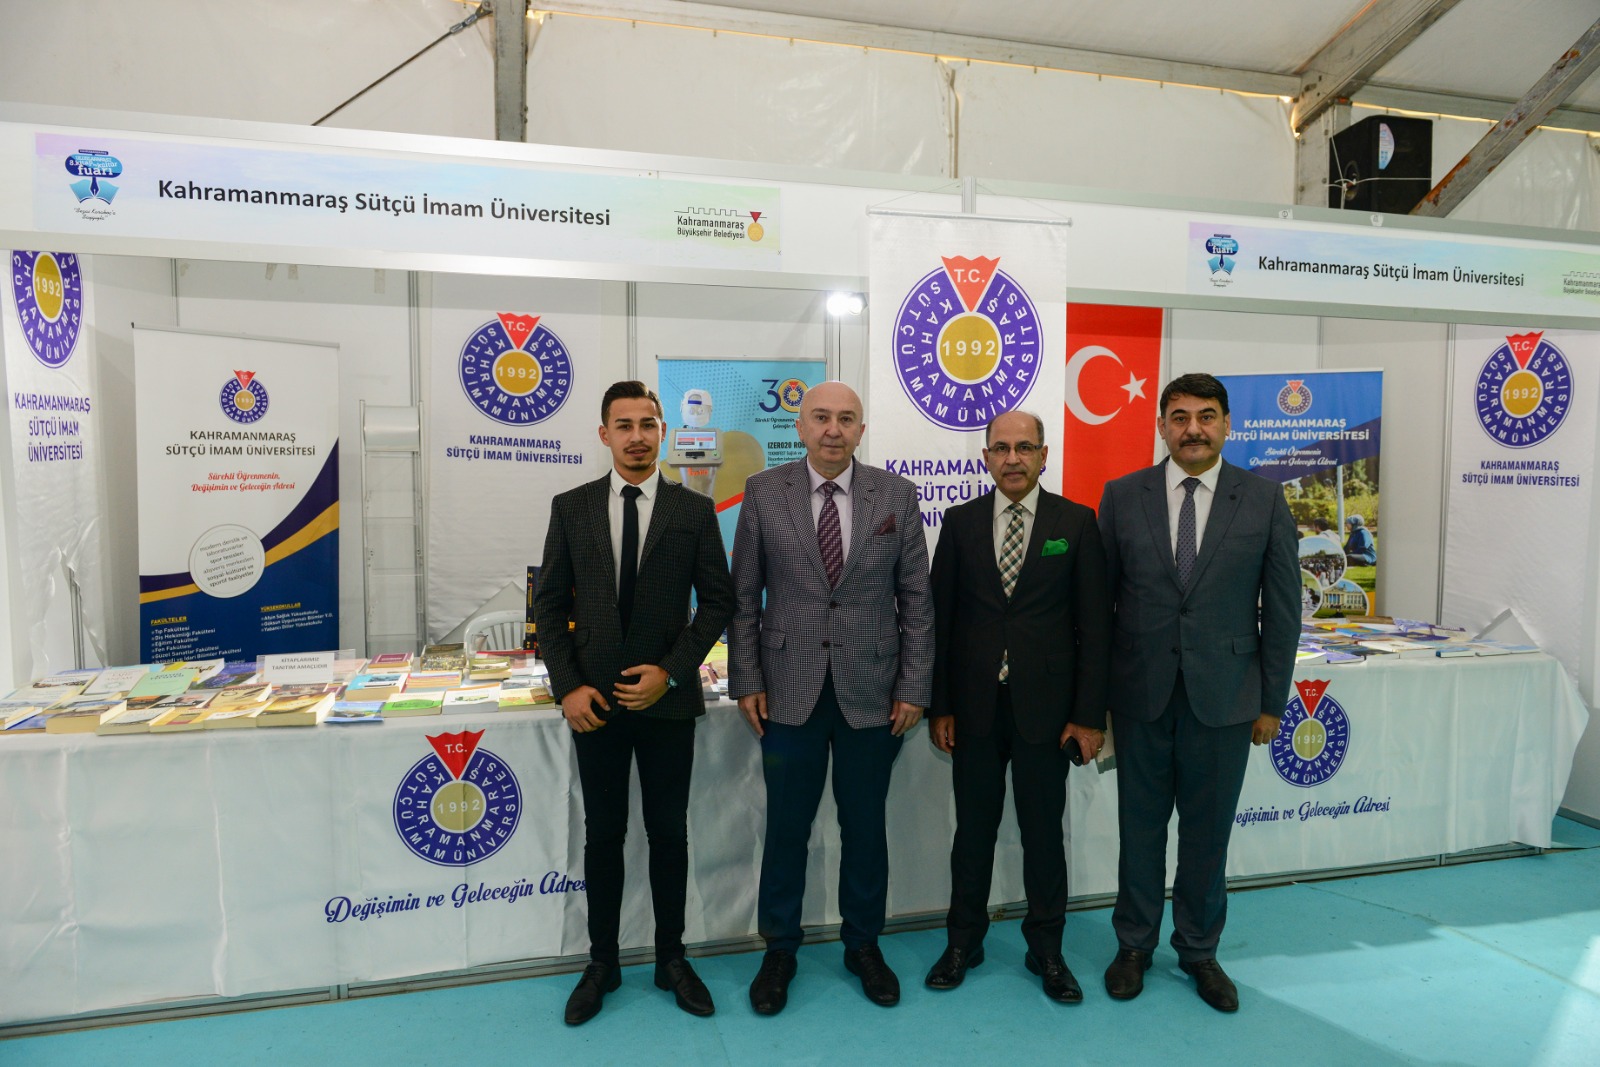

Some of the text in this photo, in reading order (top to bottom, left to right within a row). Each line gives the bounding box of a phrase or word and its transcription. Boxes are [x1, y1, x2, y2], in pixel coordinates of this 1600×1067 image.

[78, 165, 113, 175] fuarı
[158, 180, 610, 226] Kahramanmaraş Sütçü İmam Üniversitesi
[678, 215, 744, 230] Kahramanmaraş
[678, 227, 745, 240] Büyükşehir Belediyesi
[954, 268, 985, 284] T.C.
[1258, 256, 1524, 286] Kahramanmaraş Sütçü İmam Üniversitesi
[35, 276, 61, 298] 1992
[506, 321, 529, 332] T.C.
[900, 281, 1035, 422] SÜTÇÜ İMAM ÜNİVERSİTESİ
[921, 298, 1016, 401] KAHRAMANMARAŞ
[942, 340, 996, 356] 1992
[1513, 341, 1533, 352] T.C.
[463, 328, 496, 375] SÜTÇÜ
[508, 333, 568, 421] ÜNİVERSİTESİ
[480, 339, 554, 407] KAHRAMANMARAŞ
[497, 367, 537, 379] 1992
[1490, 358, 1554, 429] KAHRAMANMARAŞ
[1504, 387, 1538, 400] 1992
[15, 392, 91, 414] KAHRAMANMARAŞ
[29, 416, 79, 438] SÜTÇÜ İMAM
[1244, 419, 1346, 429] KAHRAMANMARAŞ
[190, 430, 296, 443] KAHRAMANMARAŞ
[1260, 430, 1289, 440] İMAM
[1292, 429, 1369, 440] ÜNİVERSİTESİ
[28, 441, 83, 462] ÜNİVERSİTESİ
[166, 444, 315, 457] SÜTÇÜ İMAM ÜNİVERSİTESİ
[470, 435, 561, 452] KAHRAMANMARAŞ
[447, 447, 582, 464] SÜTÇÜ İMAM ÜNİVERSİTESİ
[1481, 460, 1560, 473] KAHRAMANMARAŞ
[208, 472, 235, 480] Sürekli
[1462, 472, 1580, 487] SÜTÇÜ İMAM ÜNİVERSİTESİ
[191, 483, 228, 493] Değişimin
[240, 483, 271, 492] Geleceğin
[273, 481, 295, 490] Adresi
[916, 480, 971, 503] SÜTÇÜ
[151, 616, 186, 626] FAKÜLTELER
[165, 632, 191, 640] Hekimliği
[192, 628, 215, 636] Fakültesi
[1305, 689, 1318, 697] T.C.
[445, 743, 467, 754] T.C.
[1283, 710, 1336, 772] KAHRAMANMARAŞ
[399, 757, 516, 861] SÜTÇÜ İMAM ÜNİVERSİTESİ
[416, 768, 500, 846] KAHRAMANMARAŞ
[437, 799, 480, 814] 1992
[1234, 795, 1391, 827] eğişimin ve Geleceğin Adresi
[324, 870, 587, 923] Değişimin ve Geleceğin Adres
